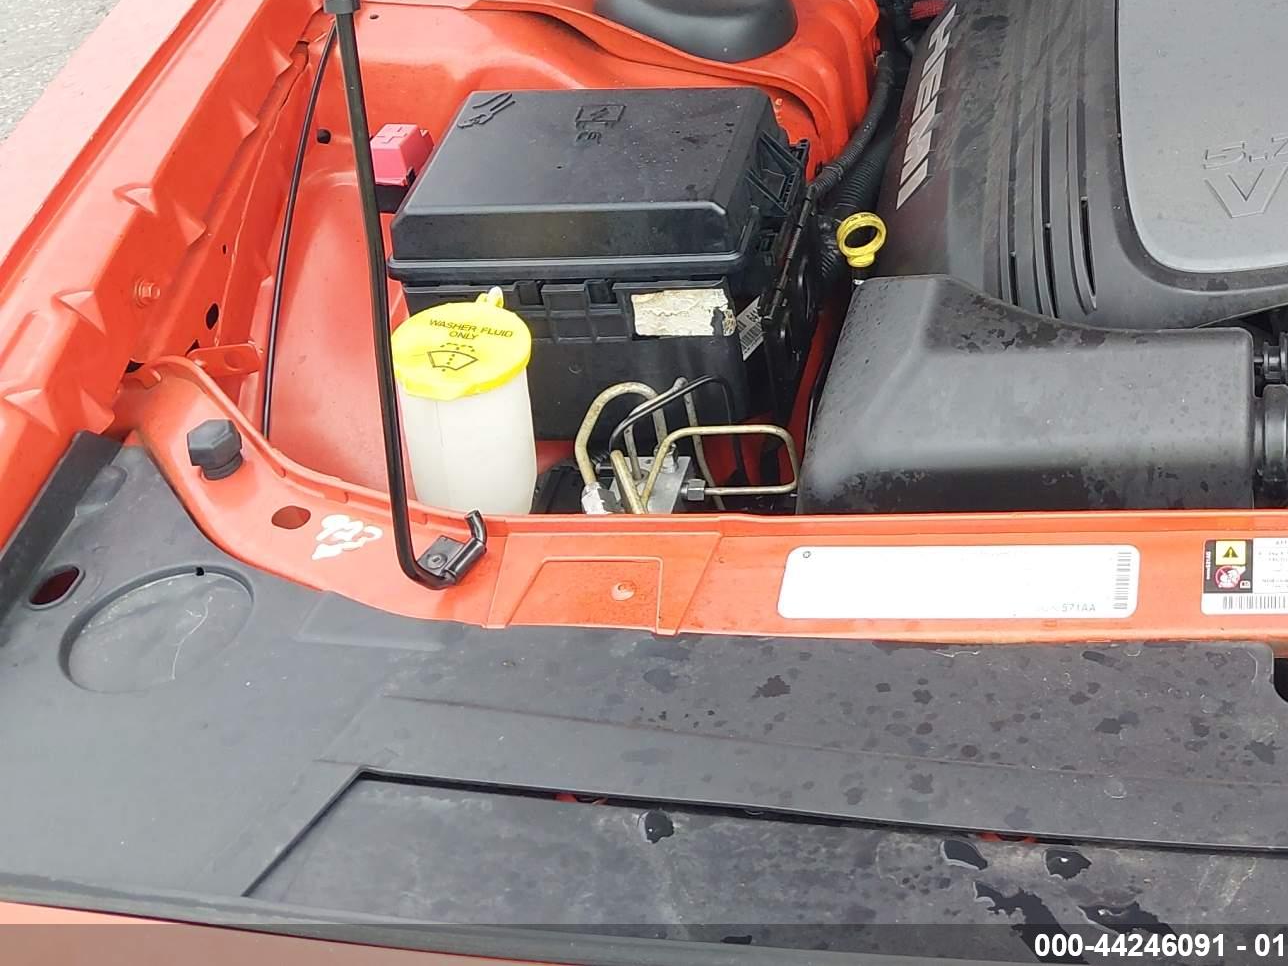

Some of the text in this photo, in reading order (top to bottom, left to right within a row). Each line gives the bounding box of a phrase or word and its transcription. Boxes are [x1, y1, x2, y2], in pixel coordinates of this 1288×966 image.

[895, 2, 958, 210] HEMI
[429, 319, 514, 338] WASHER FLUID
[448, 331, 479, 341] ONLY
